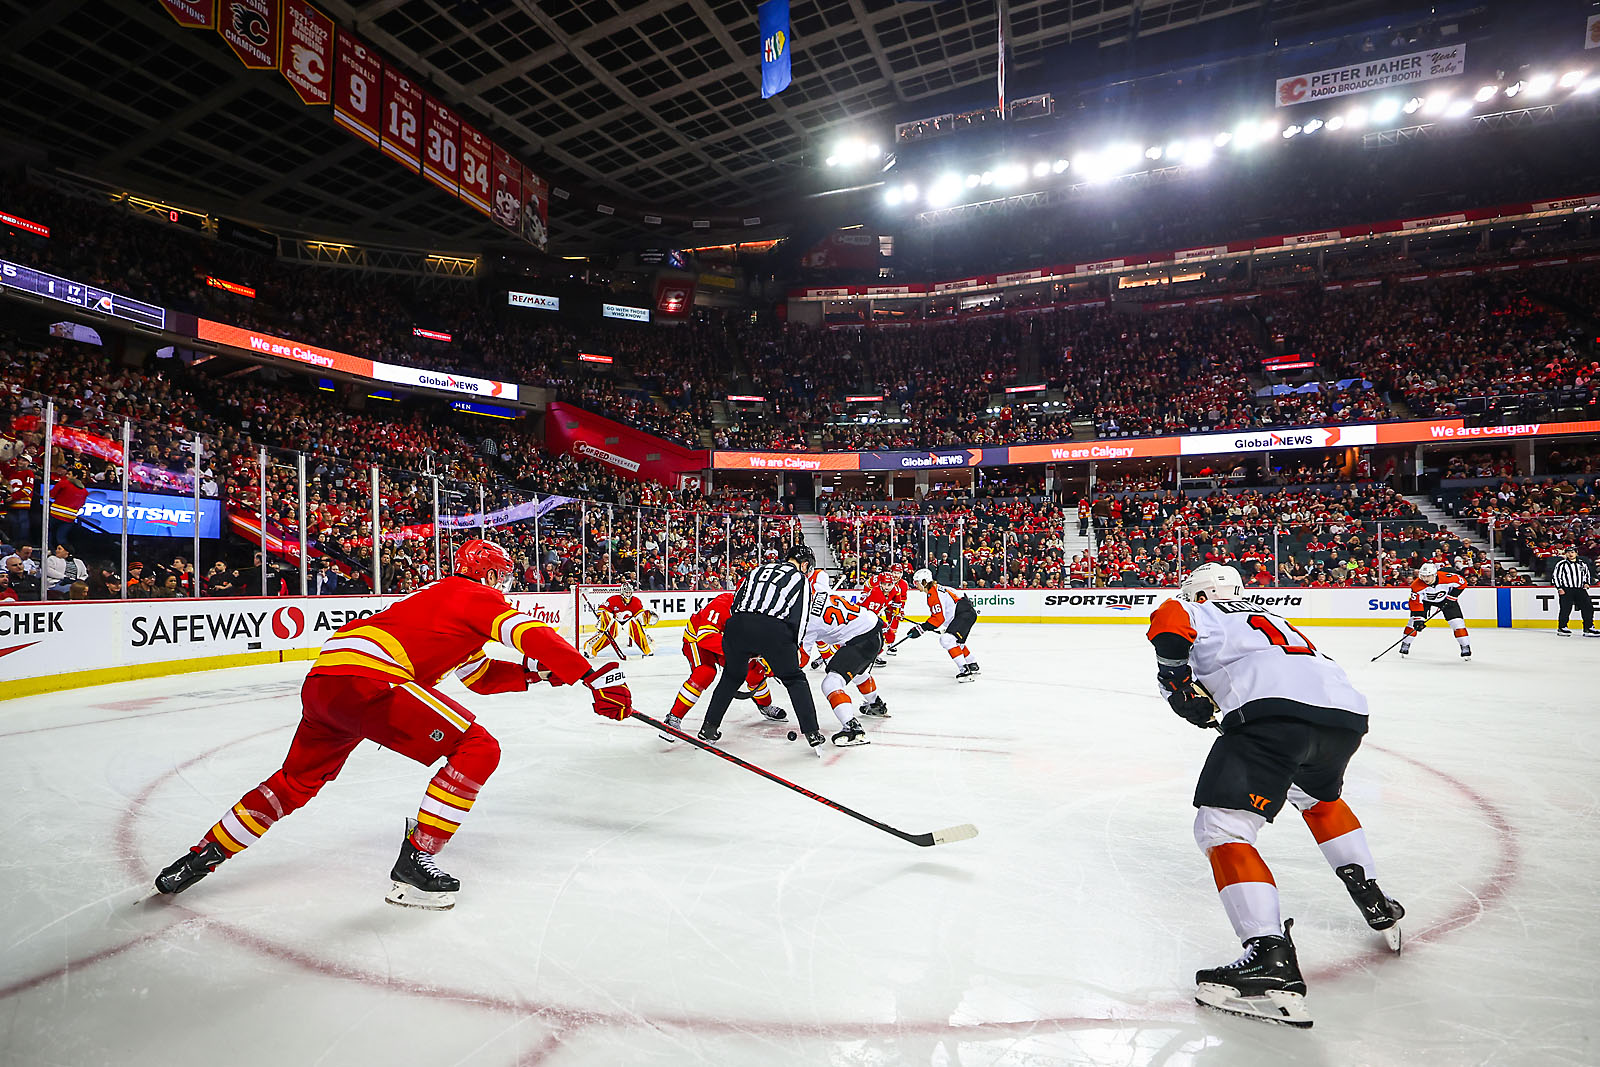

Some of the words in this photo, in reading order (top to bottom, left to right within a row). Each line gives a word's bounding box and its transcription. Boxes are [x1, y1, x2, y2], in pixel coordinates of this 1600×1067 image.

[289, 5, 328, 41] 2021-2022
[294, 19, 323, 46] PACIFIC
[225, 28, 272, 66] CHAMPIONS
[291, 26, 325, 57] DIVISION
[1311, 68, 1361, 87] PETER
[1365, 56, 1422, 77] MAHER
[286, 68, 327, 101] CHAMPIONS
[349, 73, 368, 113] 9
[1310, 86, 1337, 97] RADIO
[1338, 77, 1390, 93] BROADCAST
[1391, 70, 1422, 83] BOOTH
[388, 101, 417, 148] 12
[427, 127, 457, 172] 30
[463, 152, 489, 194] 34
[68, 284, 81, 296] 17
[512, 294, 547, 306] RE/MAX
[250, 336, 270, 351] We
[271, 344, 291, 356] are
[292, 347, 334, 369] Calgary
[418, 375, 449, 387] Global
[454, 382, 479, 392] NEWS
[1234, 437, 1273, 448] Global
[1279, 435, 1313, 446] NEWS
[1430, 426, 1454, 437] We
[1456, 427, 1481, 436] are
[1482, 424, 1540, 436] Calgary
[593, 450, 610, 460] RED
[750, 457, 766, 466] We
[767, 458, 783, 466] are
[784, 458, 821, 469] Calgary
[901, 456, 932, 467] Global
[936, 455, 963, 465] NEWS
[1051, 449, 1069, 459] We
[1071, 449, 1089, 457] are
[1090, 446, 1134, 458] Calgary
[759, 568, 785, 584] 87
[650, 597, 686, 613] THE
[823, 595, 860, 626] 22
[868, 602, 881, 611] 27
[1045, 594, 1158, 606] SPORTSNET
[313, 609, 382, 632] AERO
[707, 609, 721, 625] 11
[131, 611, 268, 647] SAFEWAY
